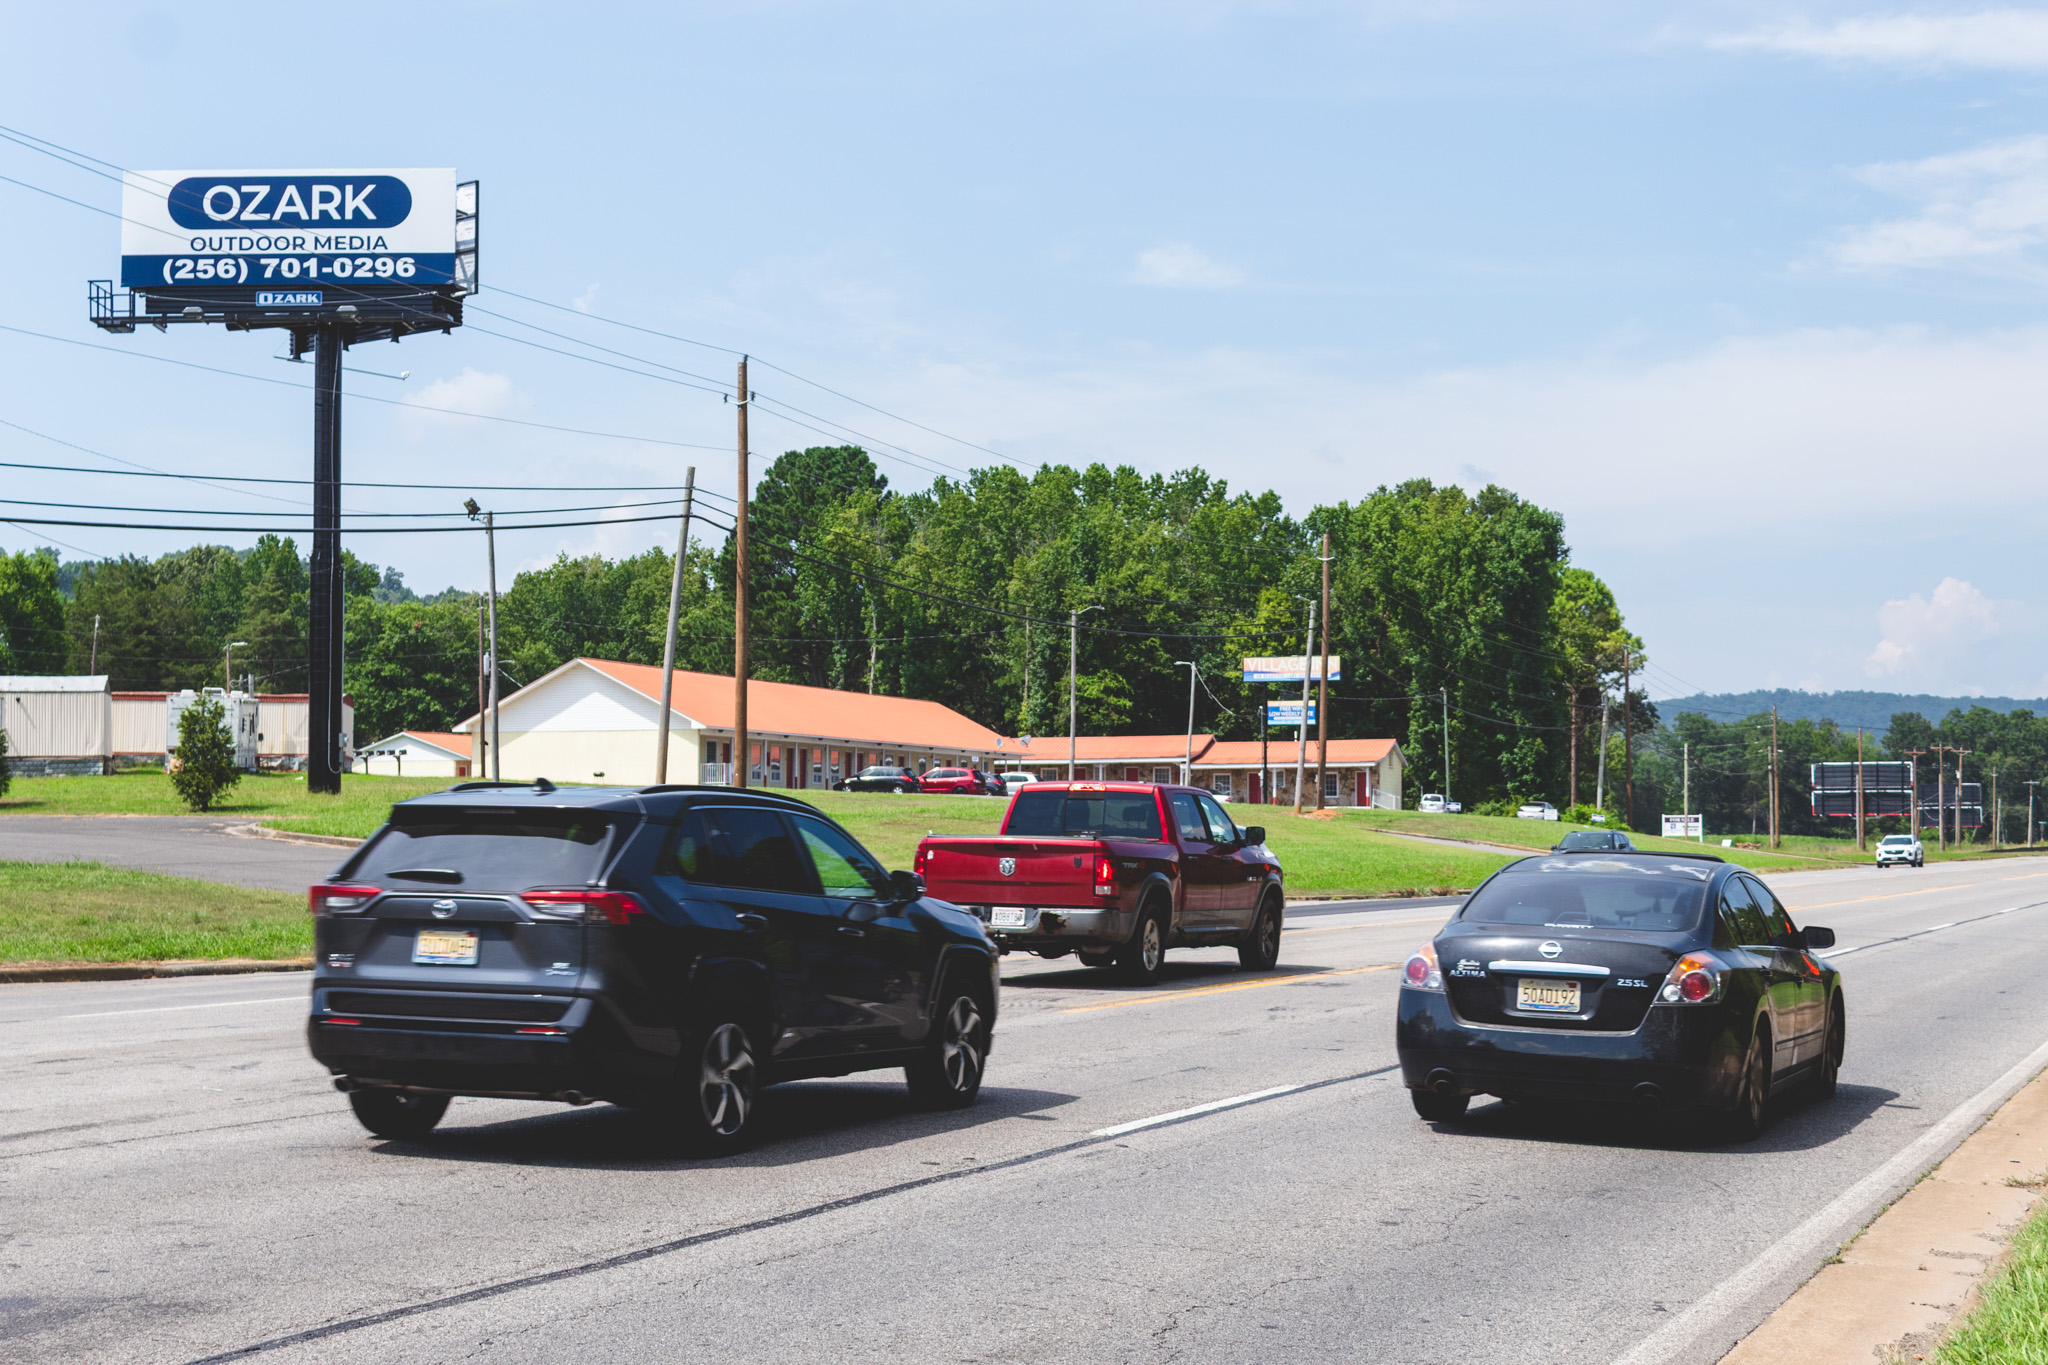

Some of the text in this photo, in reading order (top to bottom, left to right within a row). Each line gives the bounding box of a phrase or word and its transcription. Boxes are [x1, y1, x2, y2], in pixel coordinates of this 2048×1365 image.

[202, 184, 377, 221] OZARK
[190, 235, 388, 252] OUTDOOR MEDIA
[162, 257, 416, 284] (256) 701-0296
[258, 293, 319, 304] OZARK
[1247, 657, 1307, 672] VILLAGE
[1449, 970, 1487, 978] ALTIMA
[1523, 987, 1576, 1005] 50AD192
